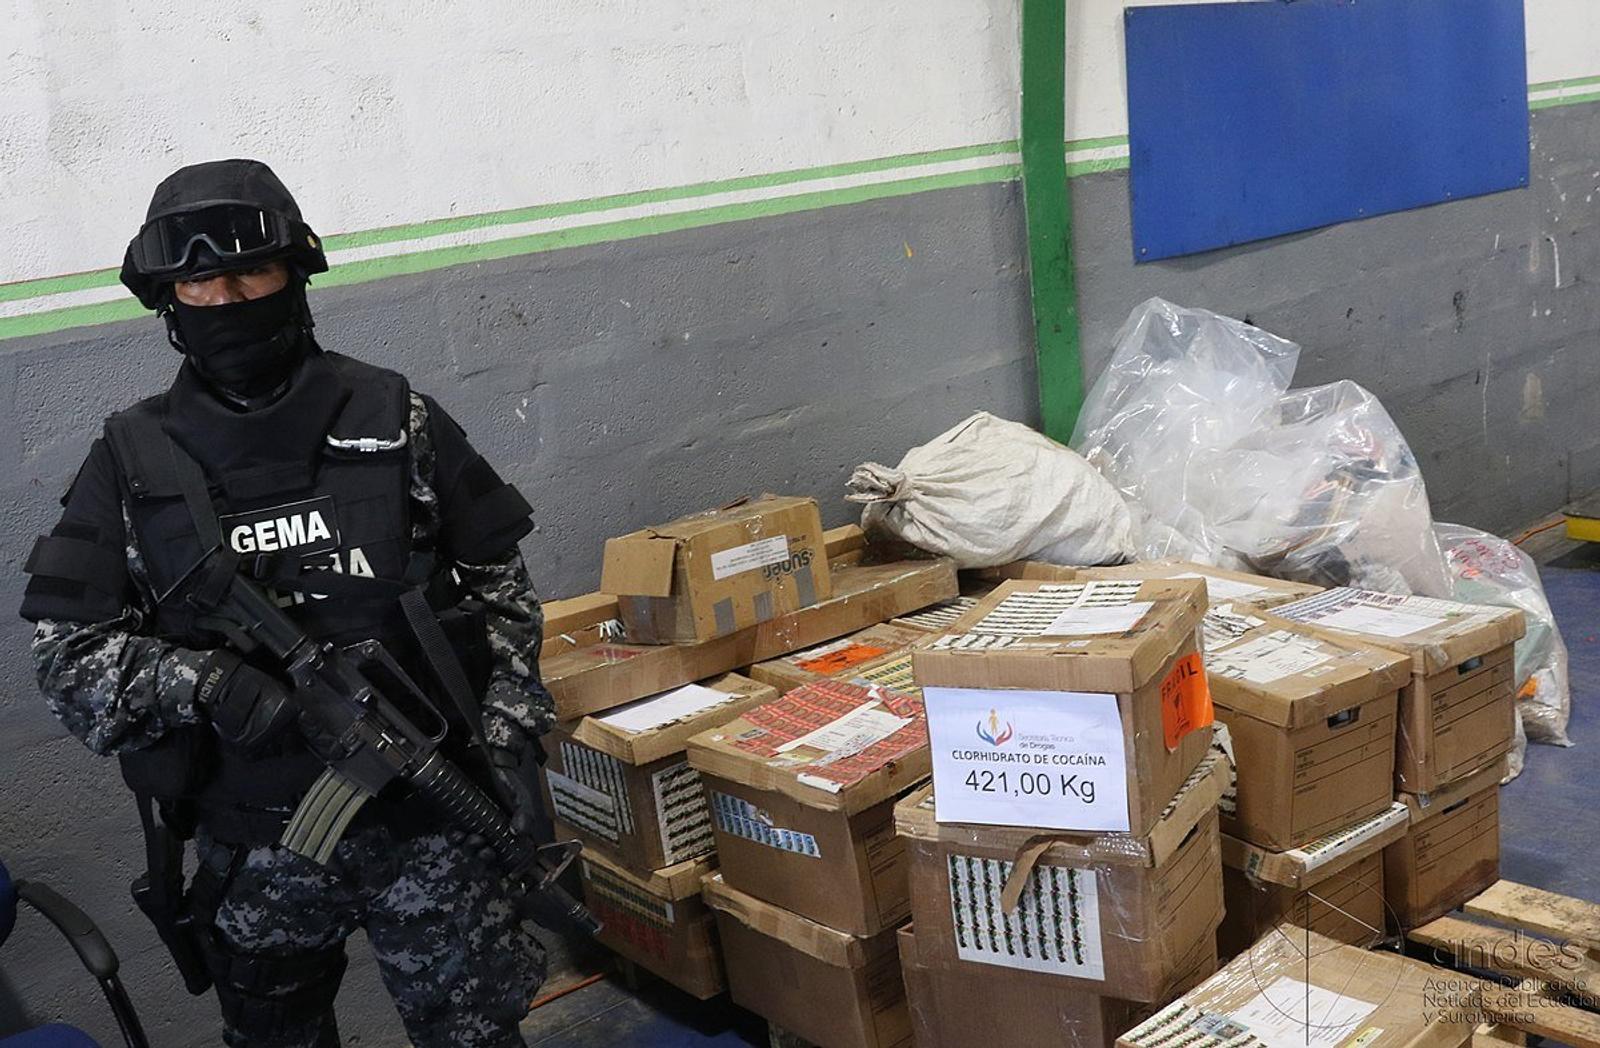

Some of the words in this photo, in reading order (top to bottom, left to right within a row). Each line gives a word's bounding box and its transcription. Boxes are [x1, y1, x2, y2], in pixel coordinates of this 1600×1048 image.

[231, 510, 331, 553] GEMA
[952, 750, 1031, 764] CLORHIDRATO
[1034, 753, 1049, 765] DE
[1052, 752, 1106, 766] COCAÍNA
[965, 769, 1051, 796] 421,00
[1061, 774, 1095, 803] Kg
